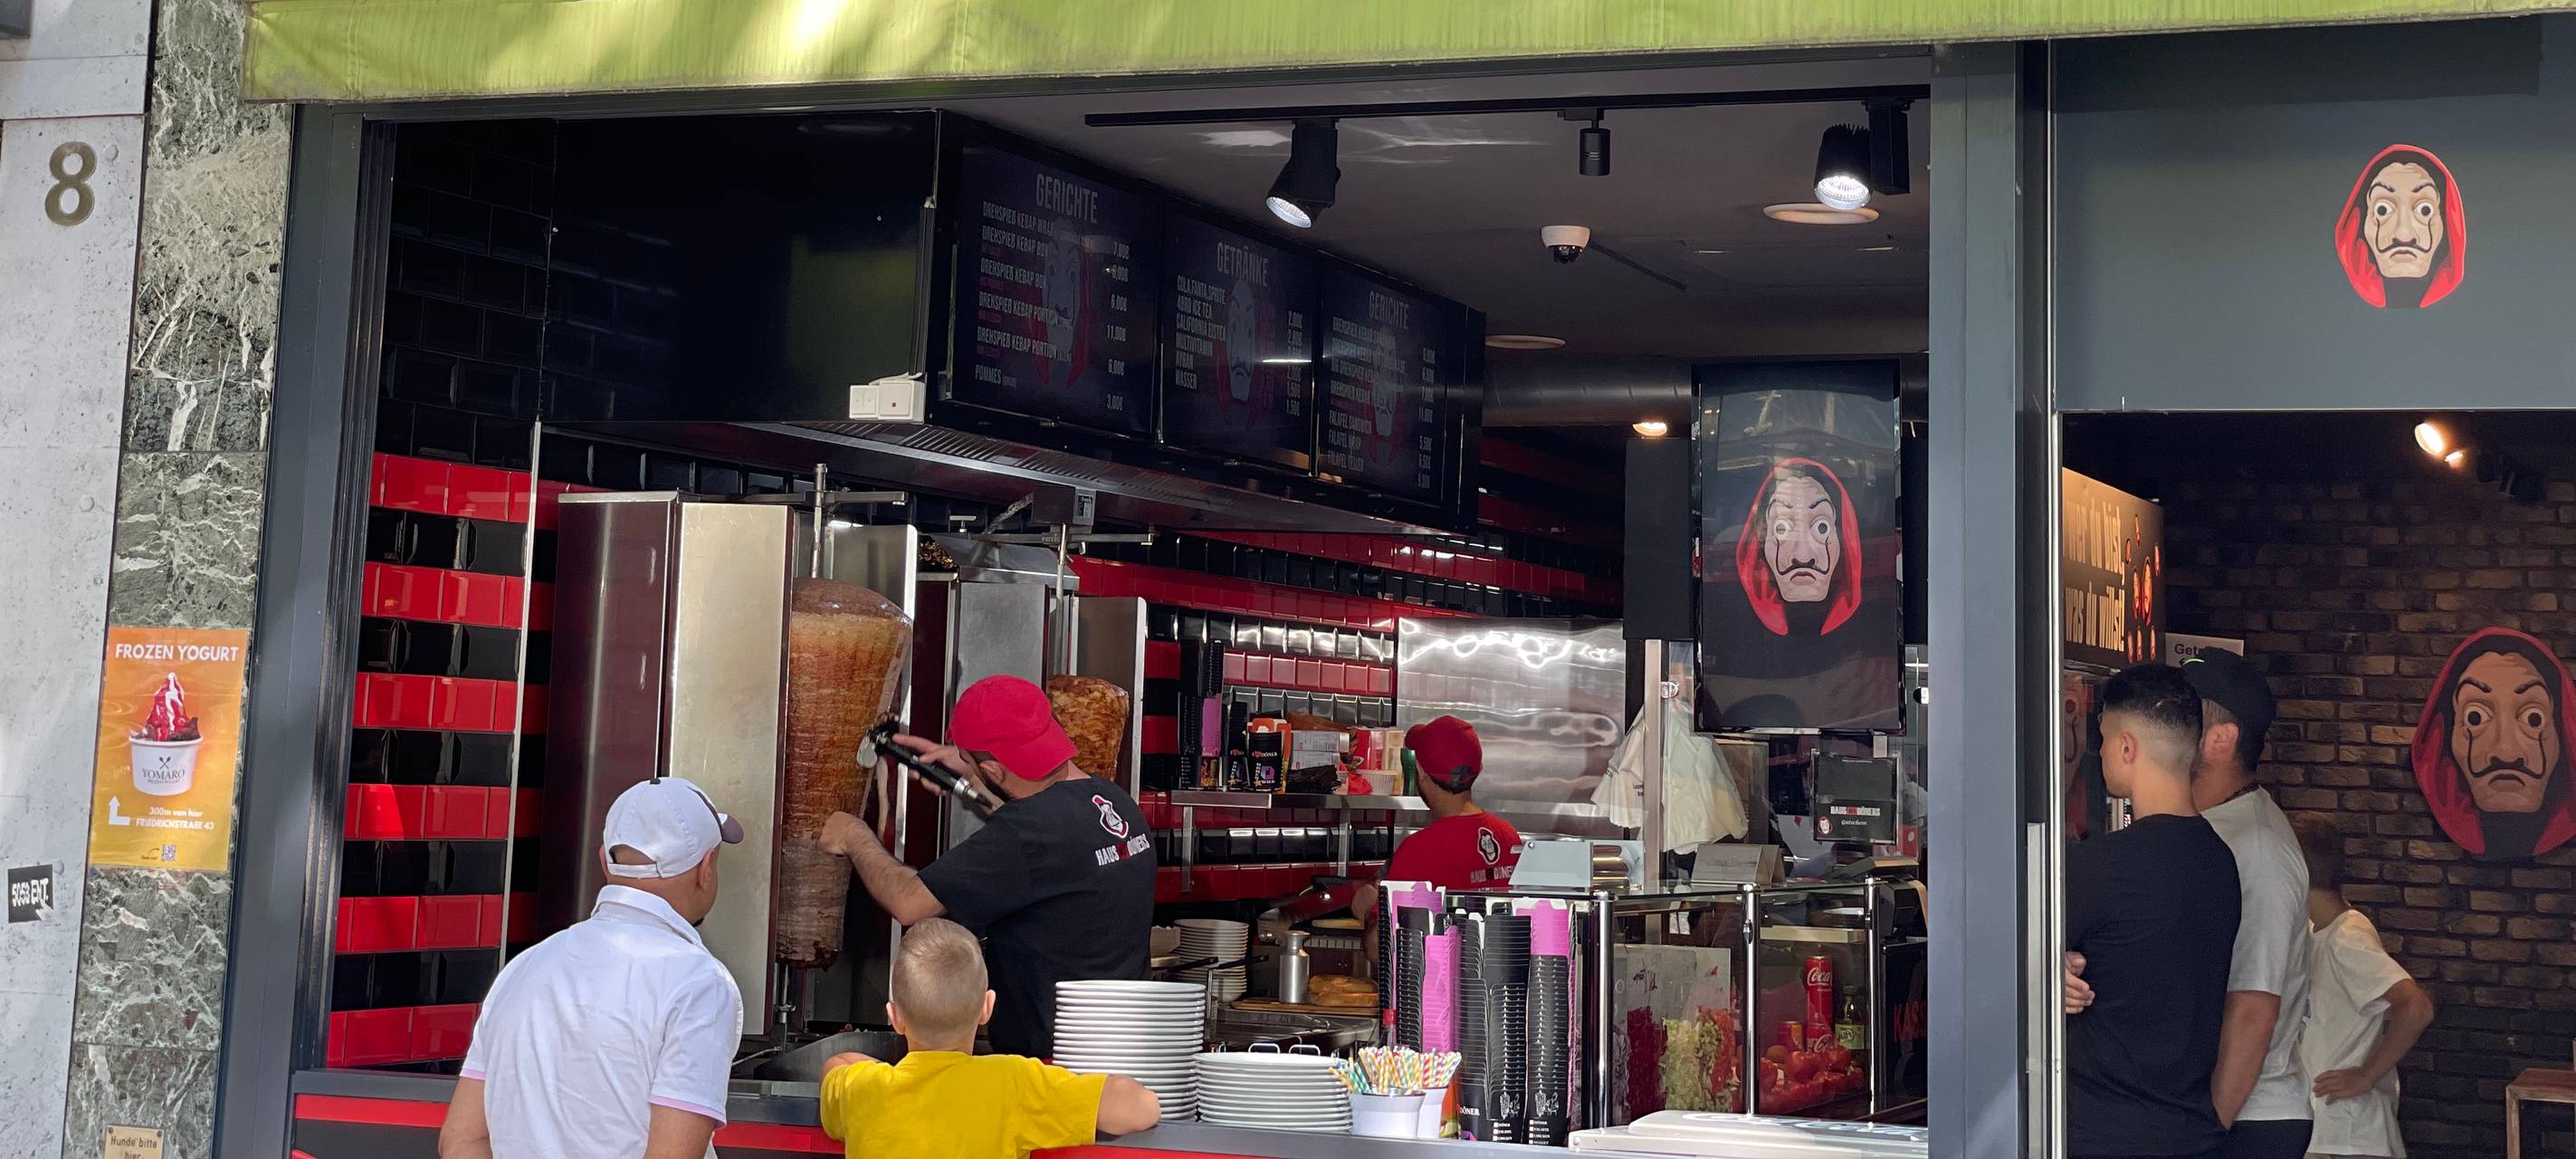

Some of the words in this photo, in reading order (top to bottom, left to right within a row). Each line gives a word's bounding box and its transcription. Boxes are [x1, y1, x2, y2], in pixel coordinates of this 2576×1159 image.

[44, 141, 97, 226] 8
[1035, 173, 1098, 225] GERICHTE
[1016, 212, 1036, 233] KEBAP
[1016, 235, 1036, 254] KEBAP
[1216, 242, 1268, 288] GETRÄNKE
[1014, 267, 1035, 286] KEBAP
[1013, 300, 1033, 319] KEBAP
[1369, 290, 1409, 330] GERICHTE
[1011, 334, 1031, 354] KEBAP
[975, 364, 1002, 385] POMMES
[2090, 496, 2103, 570] du
[2066, 586, 2085, 644] was
[2086, 580, 2097, 647] du
[115, 643, 174, 660] FROZEN
[177, 644, 239, 662] YOGURT
[2174, 643, 2202, 656] Get
[142, 768, 186, 781] YOMARO
[1095, 845, 1120, 867] HAUS
[1493, 866, 1514, 880] DÖNE
[110, 1135, 137, 1147] Hunde
[138, 1137, 157, 1149] bitte
